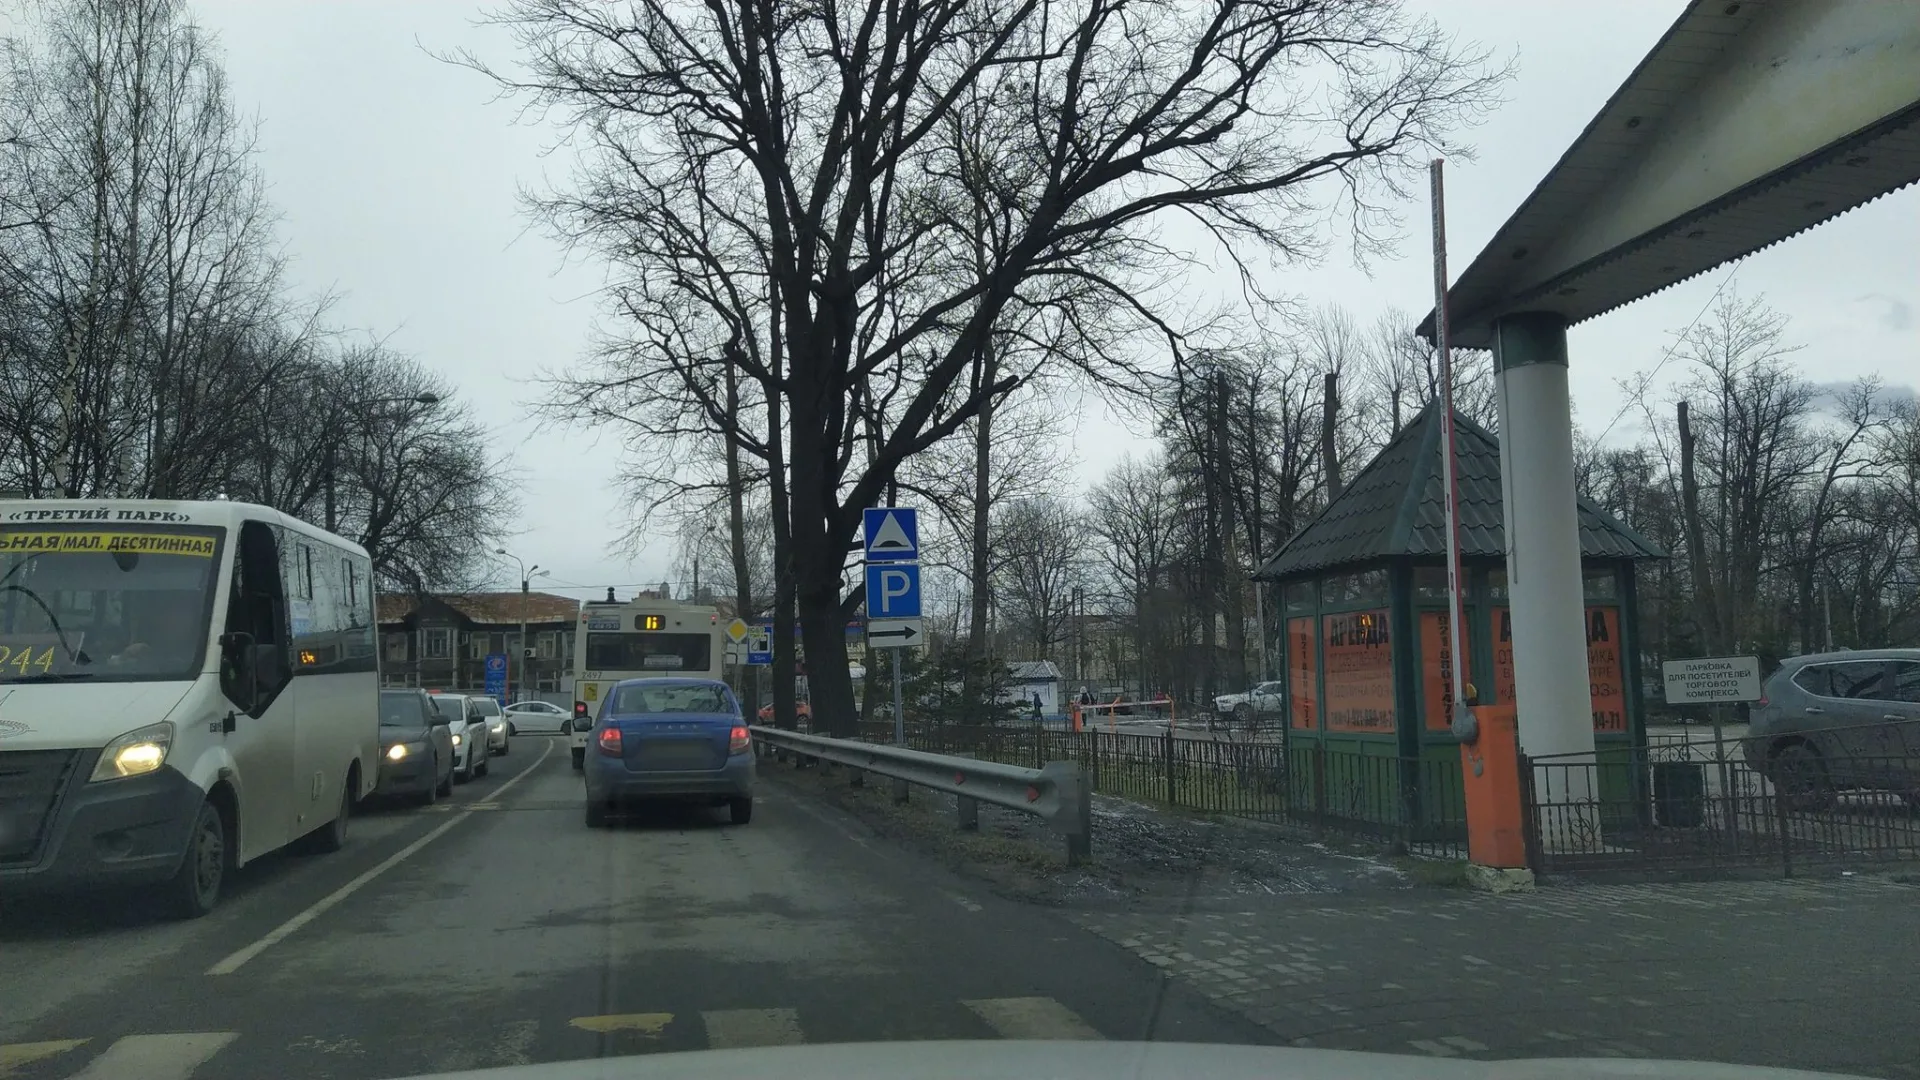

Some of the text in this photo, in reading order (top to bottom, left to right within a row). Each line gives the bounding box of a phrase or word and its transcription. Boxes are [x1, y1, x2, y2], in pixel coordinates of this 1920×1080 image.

[9, 507, 110, 521] «ТРЕТИЙ
[116, 510, 191, 523] ПАРК»
[63, 536, 213, 554] МАЛ. ДЕСЯТИННАЯ
[1686, 662, 1732, 671] ПАРКОВКА
[1668, 669, 1752, 682] ДЛЯ ПОСЕТИТЕЛЕЙ
[1685, 680, 1738, 689] ТОРГОВОГО
[1686, 689, 1740, 698] КОМПЛЕКСА
